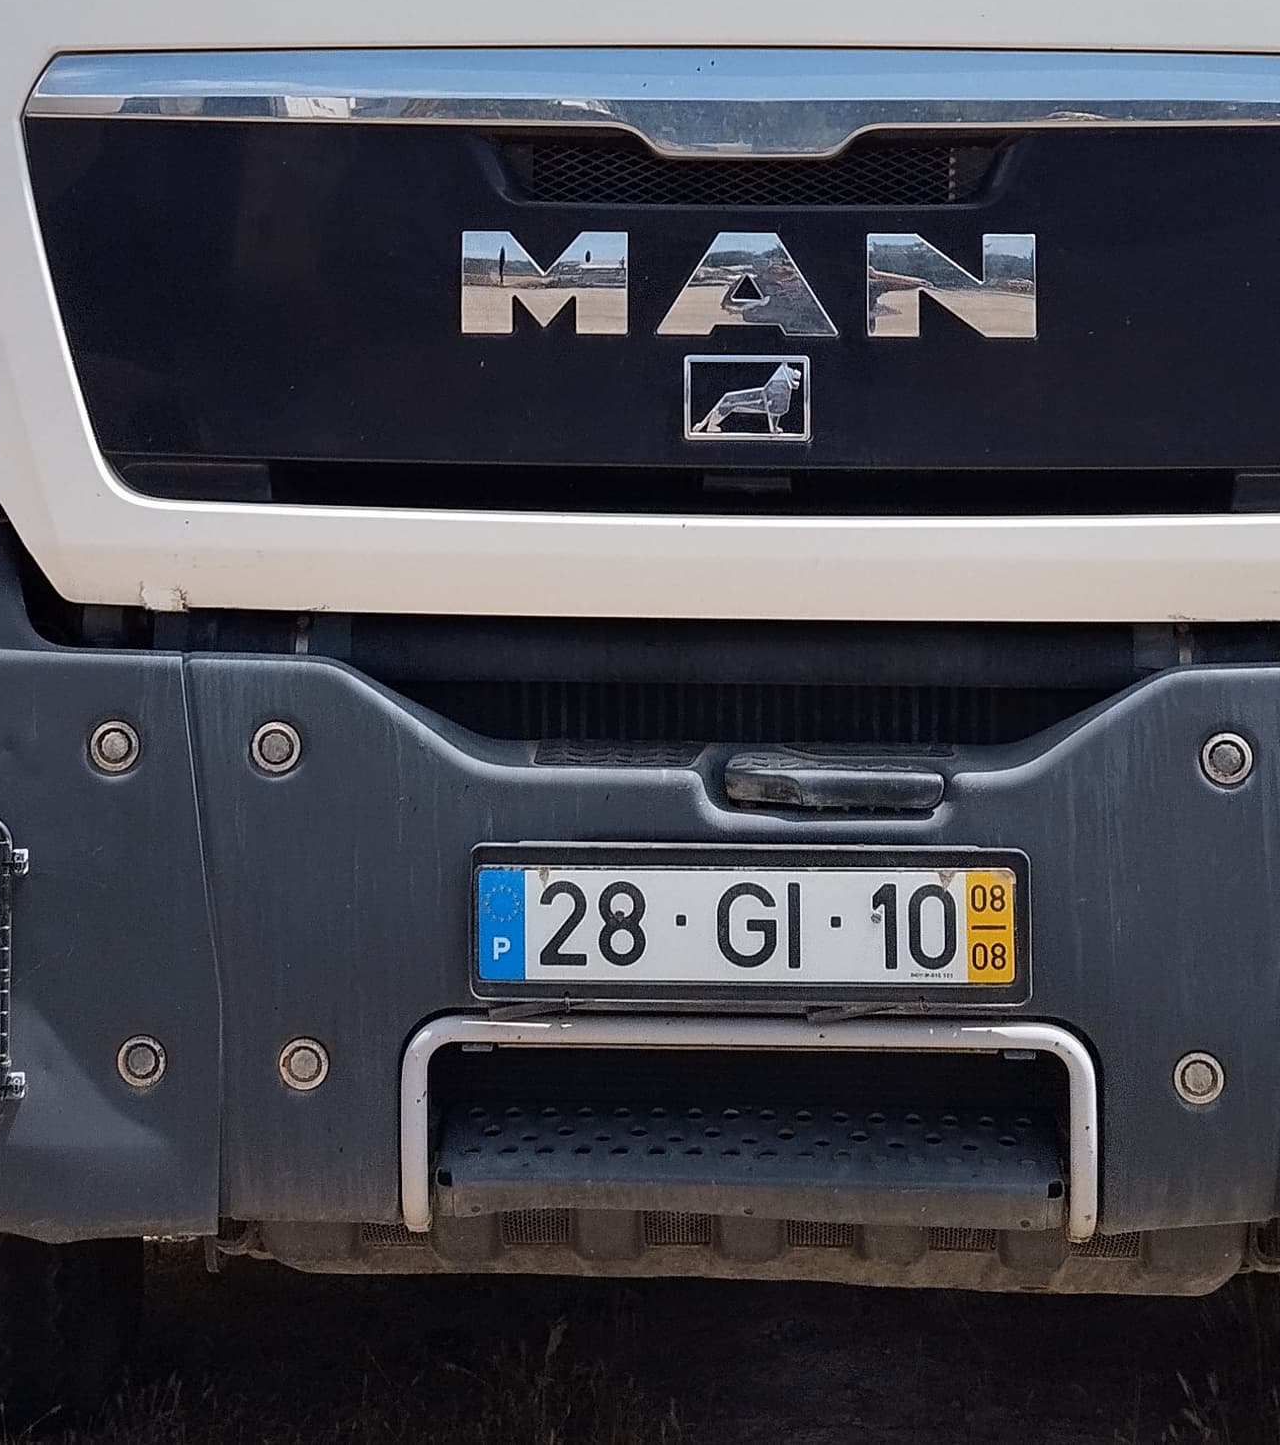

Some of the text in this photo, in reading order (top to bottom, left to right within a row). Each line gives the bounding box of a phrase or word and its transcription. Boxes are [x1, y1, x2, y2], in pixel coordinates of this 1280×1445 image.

[461, 230, 1037, 338] MAN
[970, 883, 1007, 914] 08
[492, 936, 512, 960] P
[970, 941, 1008, 972] 08
